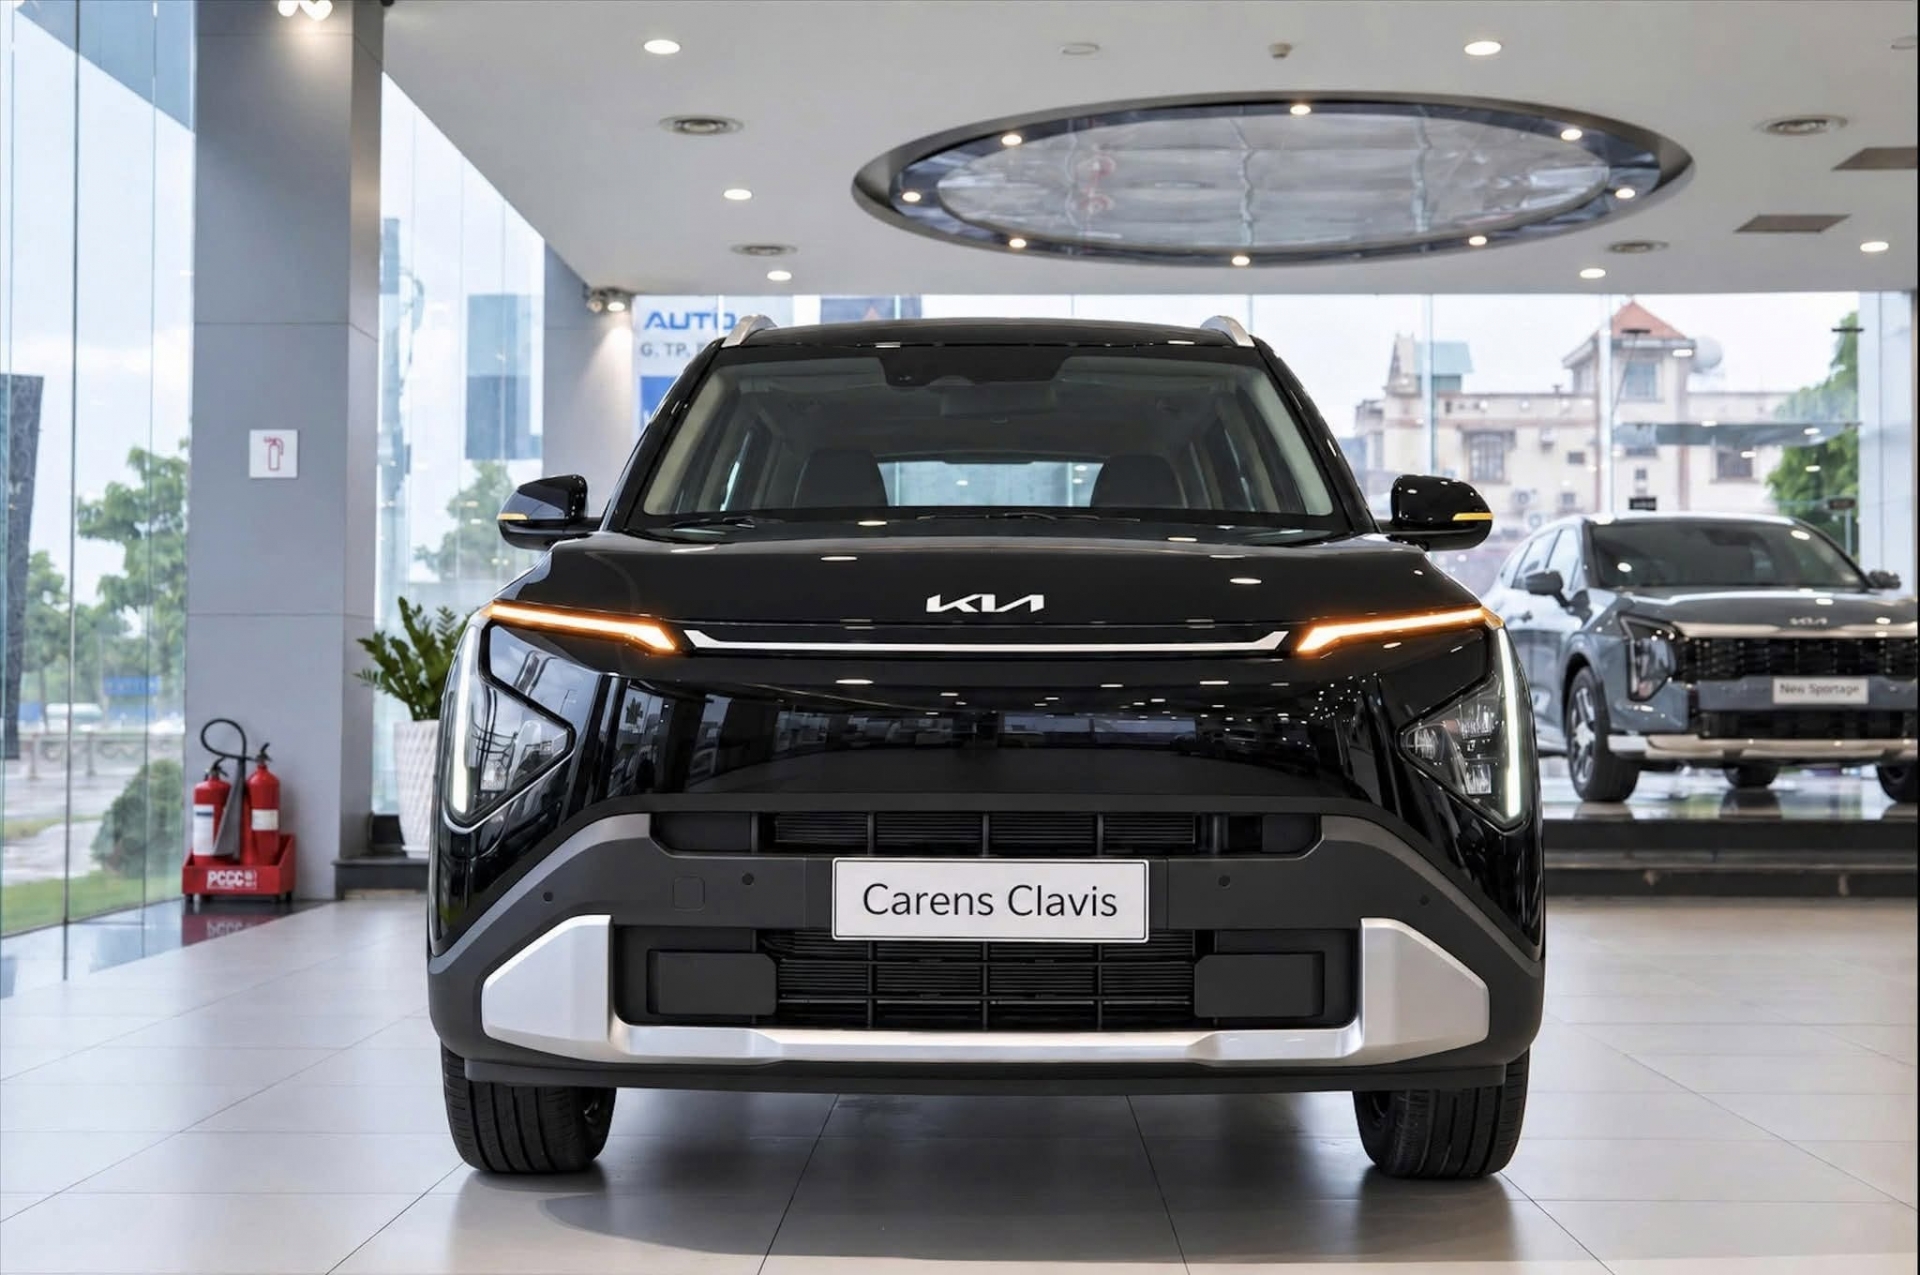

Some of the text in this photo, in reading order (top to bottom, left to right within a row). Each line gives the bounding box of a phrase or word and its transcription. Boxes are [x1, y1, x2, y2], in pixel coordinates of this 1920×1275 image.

[644, 311, 736, 330] AUTO
[926, 593, 1044, 613] KIA
[1779, 683, 1860, 697] New Sportage
[207, 870, 244, 888] PCCC
[863, 882, 1118, 916] Carens Clavis
